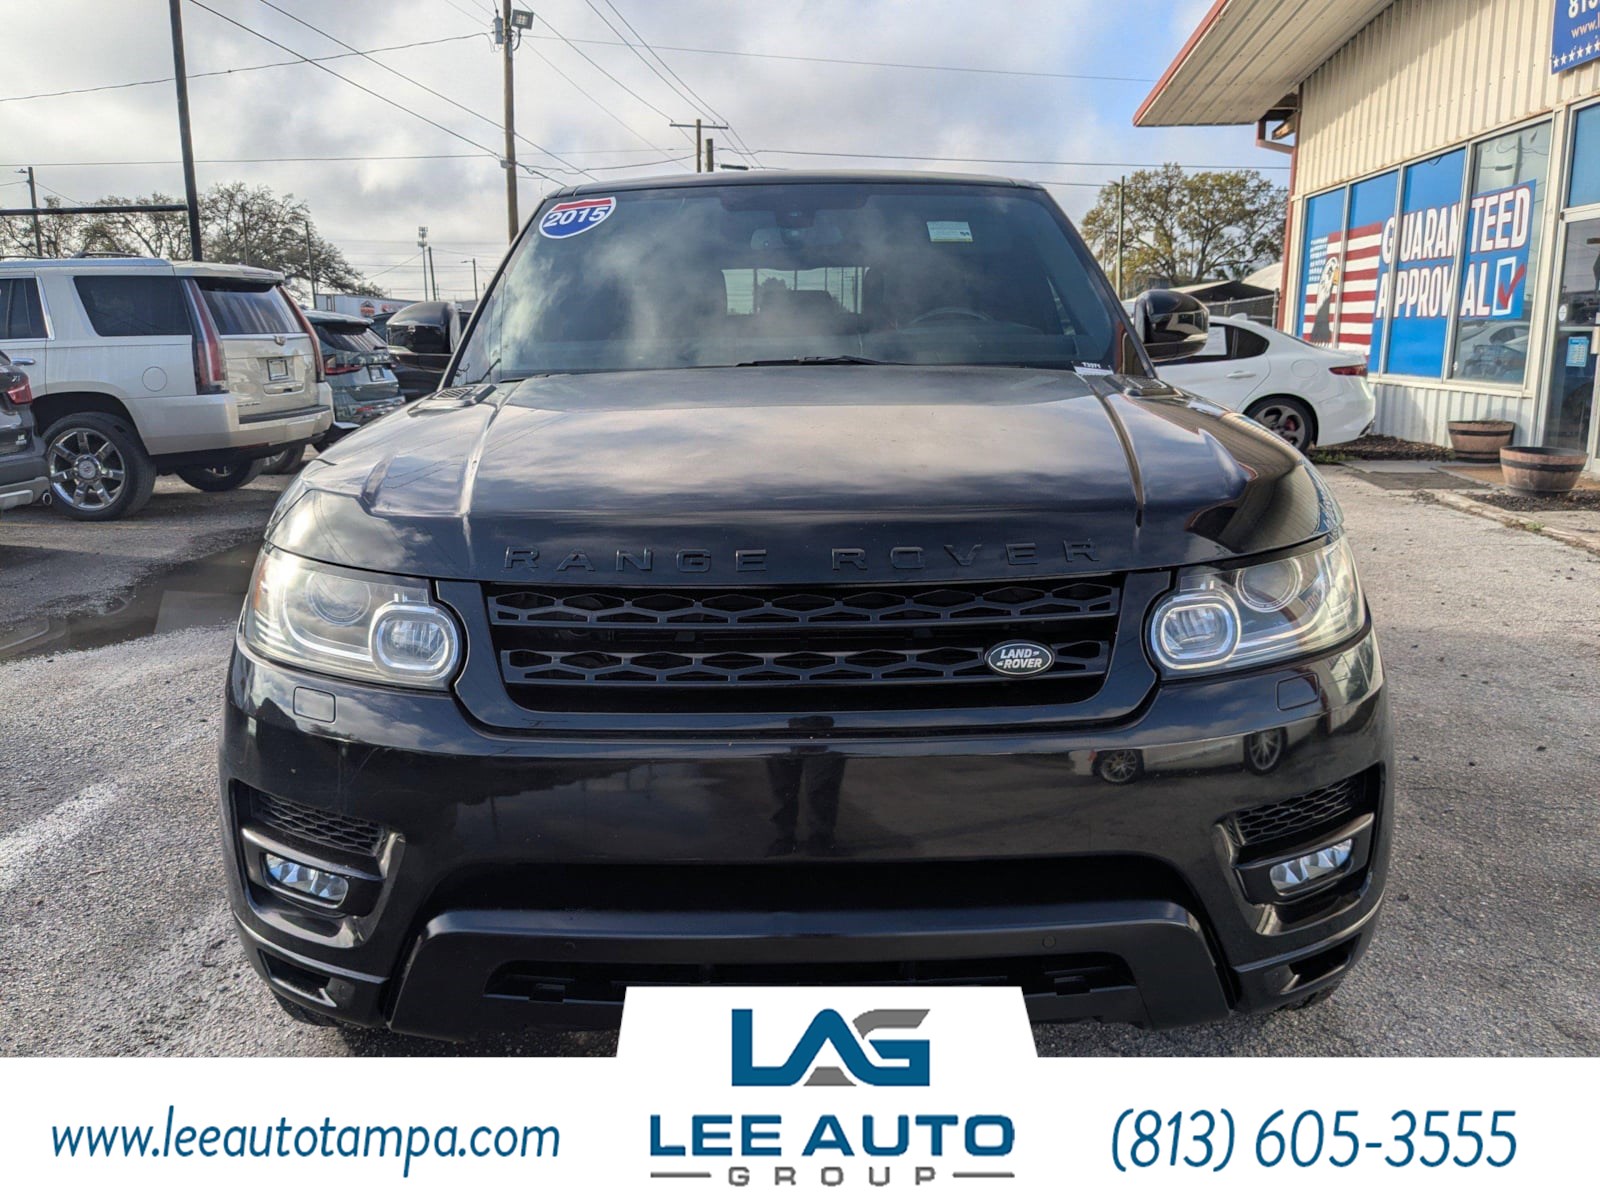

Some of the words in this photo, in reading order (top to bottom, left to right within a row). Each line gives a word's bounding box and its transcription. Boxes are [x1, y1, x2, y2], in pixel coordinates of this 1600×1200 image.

[543, 206, 609, 227] 2015
[1375, 262, 1491, 319] APPROVAL
[503, 546, 767, 572] RANGE
[831, 540, 1101, 571] ROVER
[1000, 648, 1032, 659] LAND
[1003, 658, 1042, 669] ROVER
